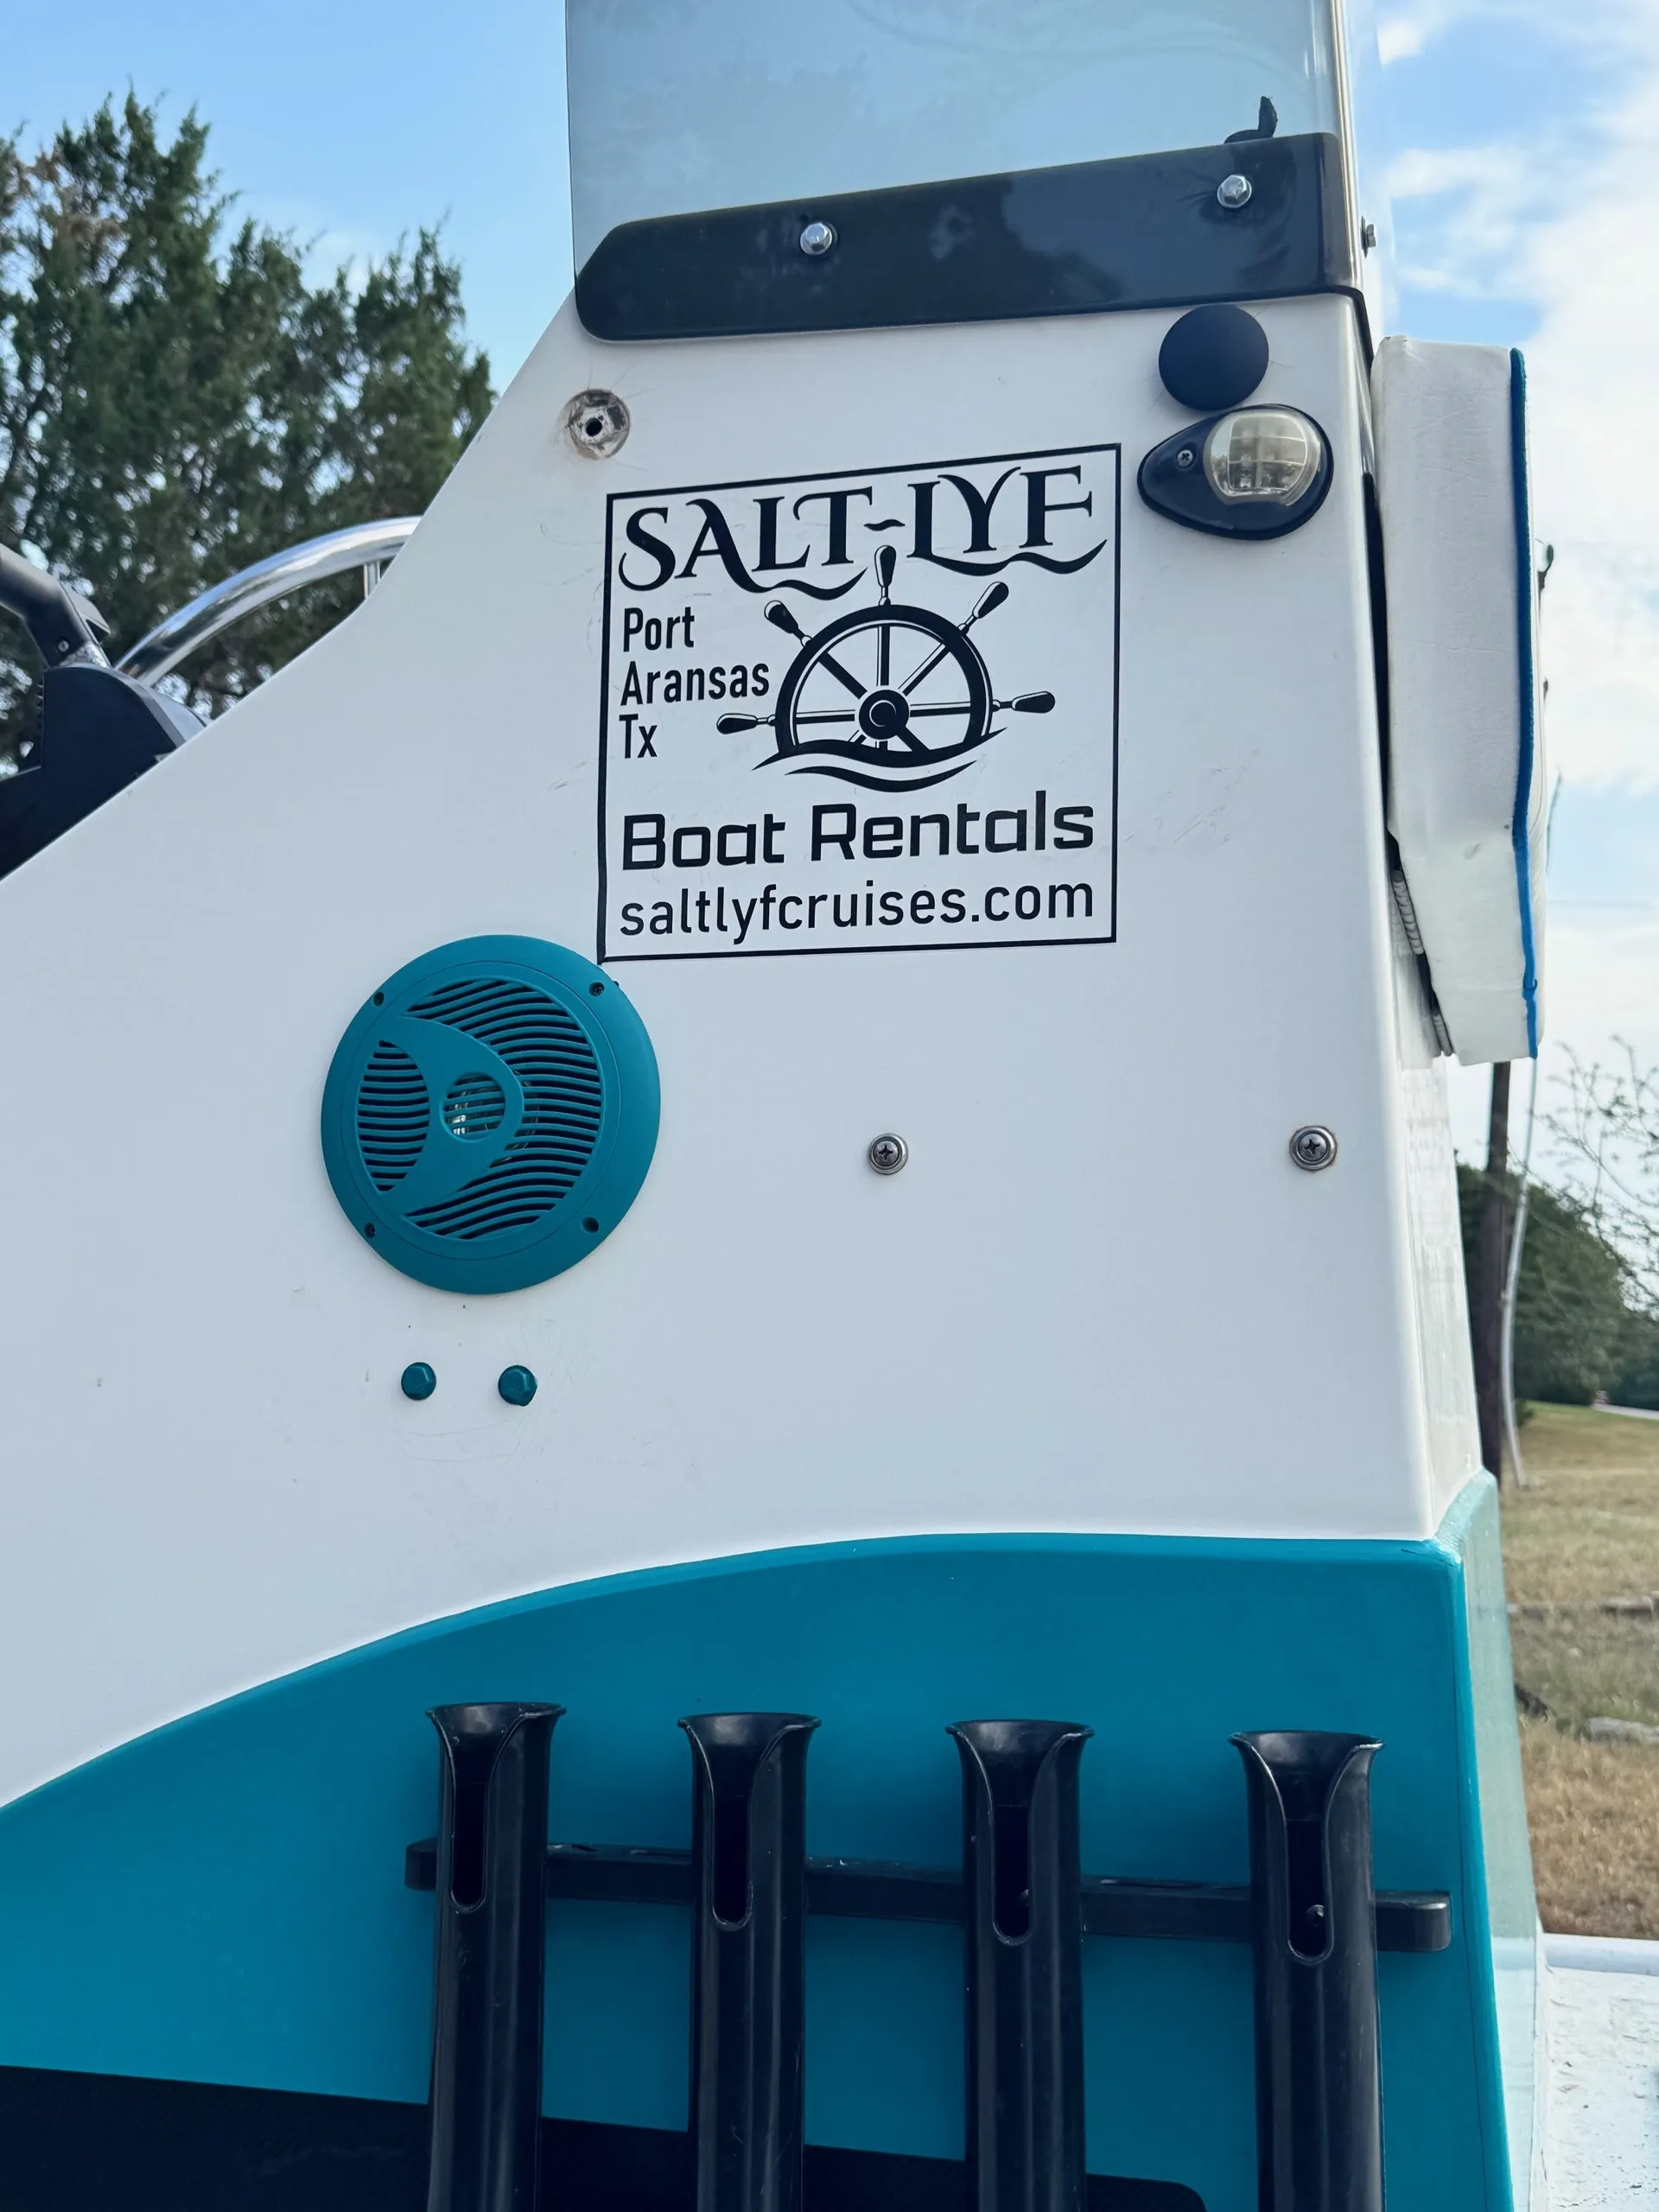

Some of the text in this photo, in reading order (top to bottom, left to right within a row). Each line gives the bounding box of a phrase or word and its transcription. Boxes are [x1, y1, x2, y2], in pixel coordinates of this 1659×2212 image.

[623, 607, 696, 652] Port
[620, 663, 770, 706] Aransas
[619, 714, 658, 759] Tx
[622, 790, 1094, 870] Boat Rentals
[620, 880, 1093, 945] saltlyfcruises.com
